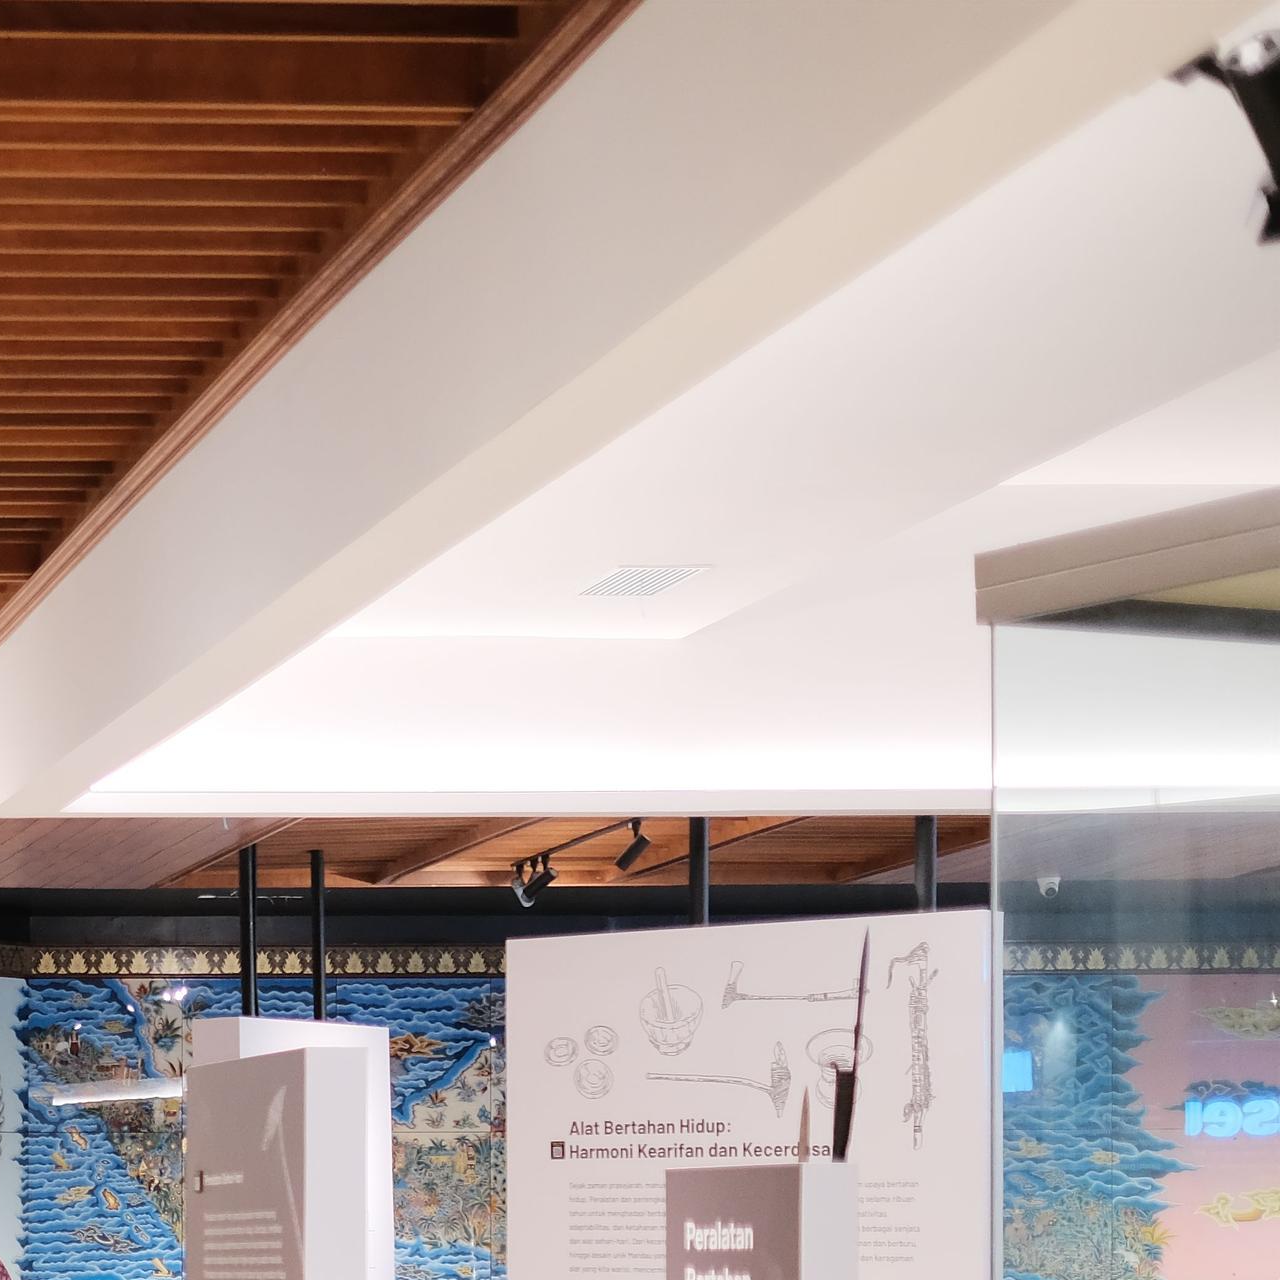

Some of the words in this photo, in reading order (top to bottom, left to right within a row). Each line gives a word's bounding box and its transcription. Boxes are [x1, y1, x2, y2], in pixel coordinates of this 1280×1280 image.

[569, 1120, 600, 1136] Alat
[604, 1119, 676, 1135] Bertahan
[679, 1118, 732, 1137] Hidup:
[569, 1142, 633, 1159] Harmoni
[637, 1142, 705, 1159] Kearifan
[708, 1142, 739, 1158] dan
[742, 1140, 833, 1158] Kecerdsa
[683, 1219, 754, 1251] Peralatan
